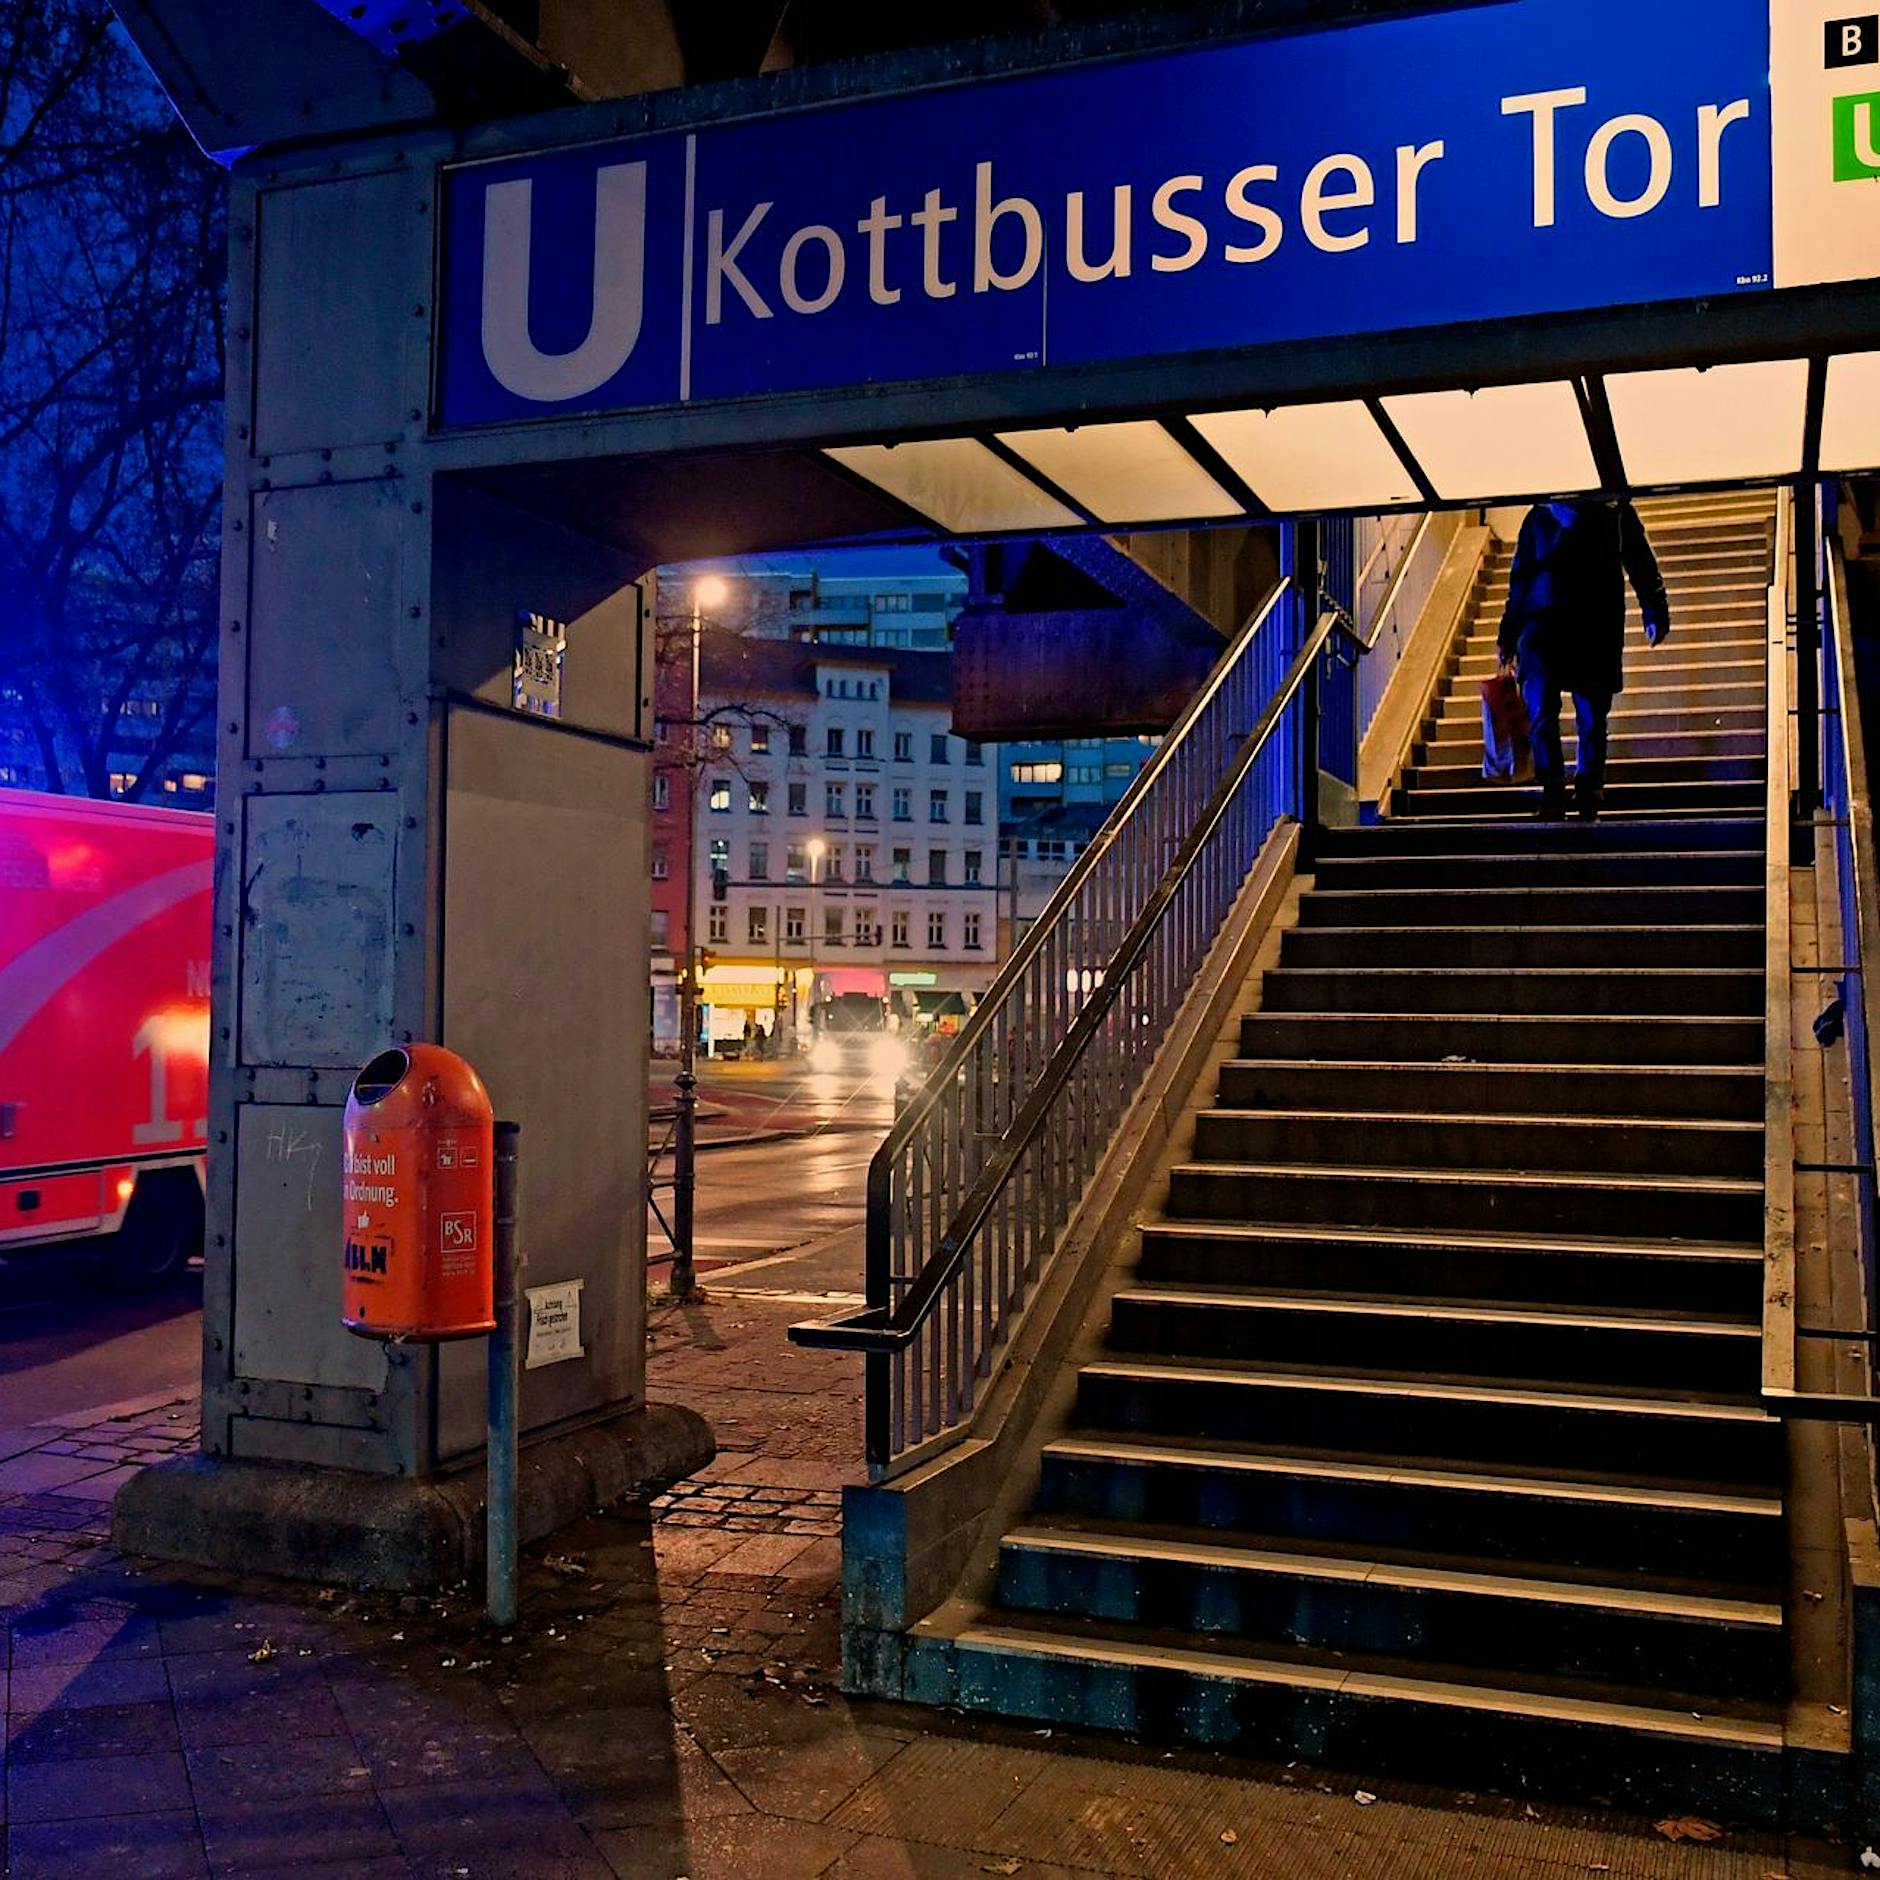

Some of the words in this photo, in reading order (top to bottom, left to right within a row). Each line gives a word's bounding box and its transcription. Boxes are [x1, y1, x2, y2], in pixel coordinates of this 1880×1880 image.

[1841, 25, 1862, 57] B
[482, 161, 647, 401] U
[706, 139, 1445, 325] Kottbusser
[1501, 86, 1750, 229] Tor
[373, 1154, 395, 1175] voll
[350, 1180, 400, 1208] Ordnung.
[444, 1220, 473, 1245] BSR
